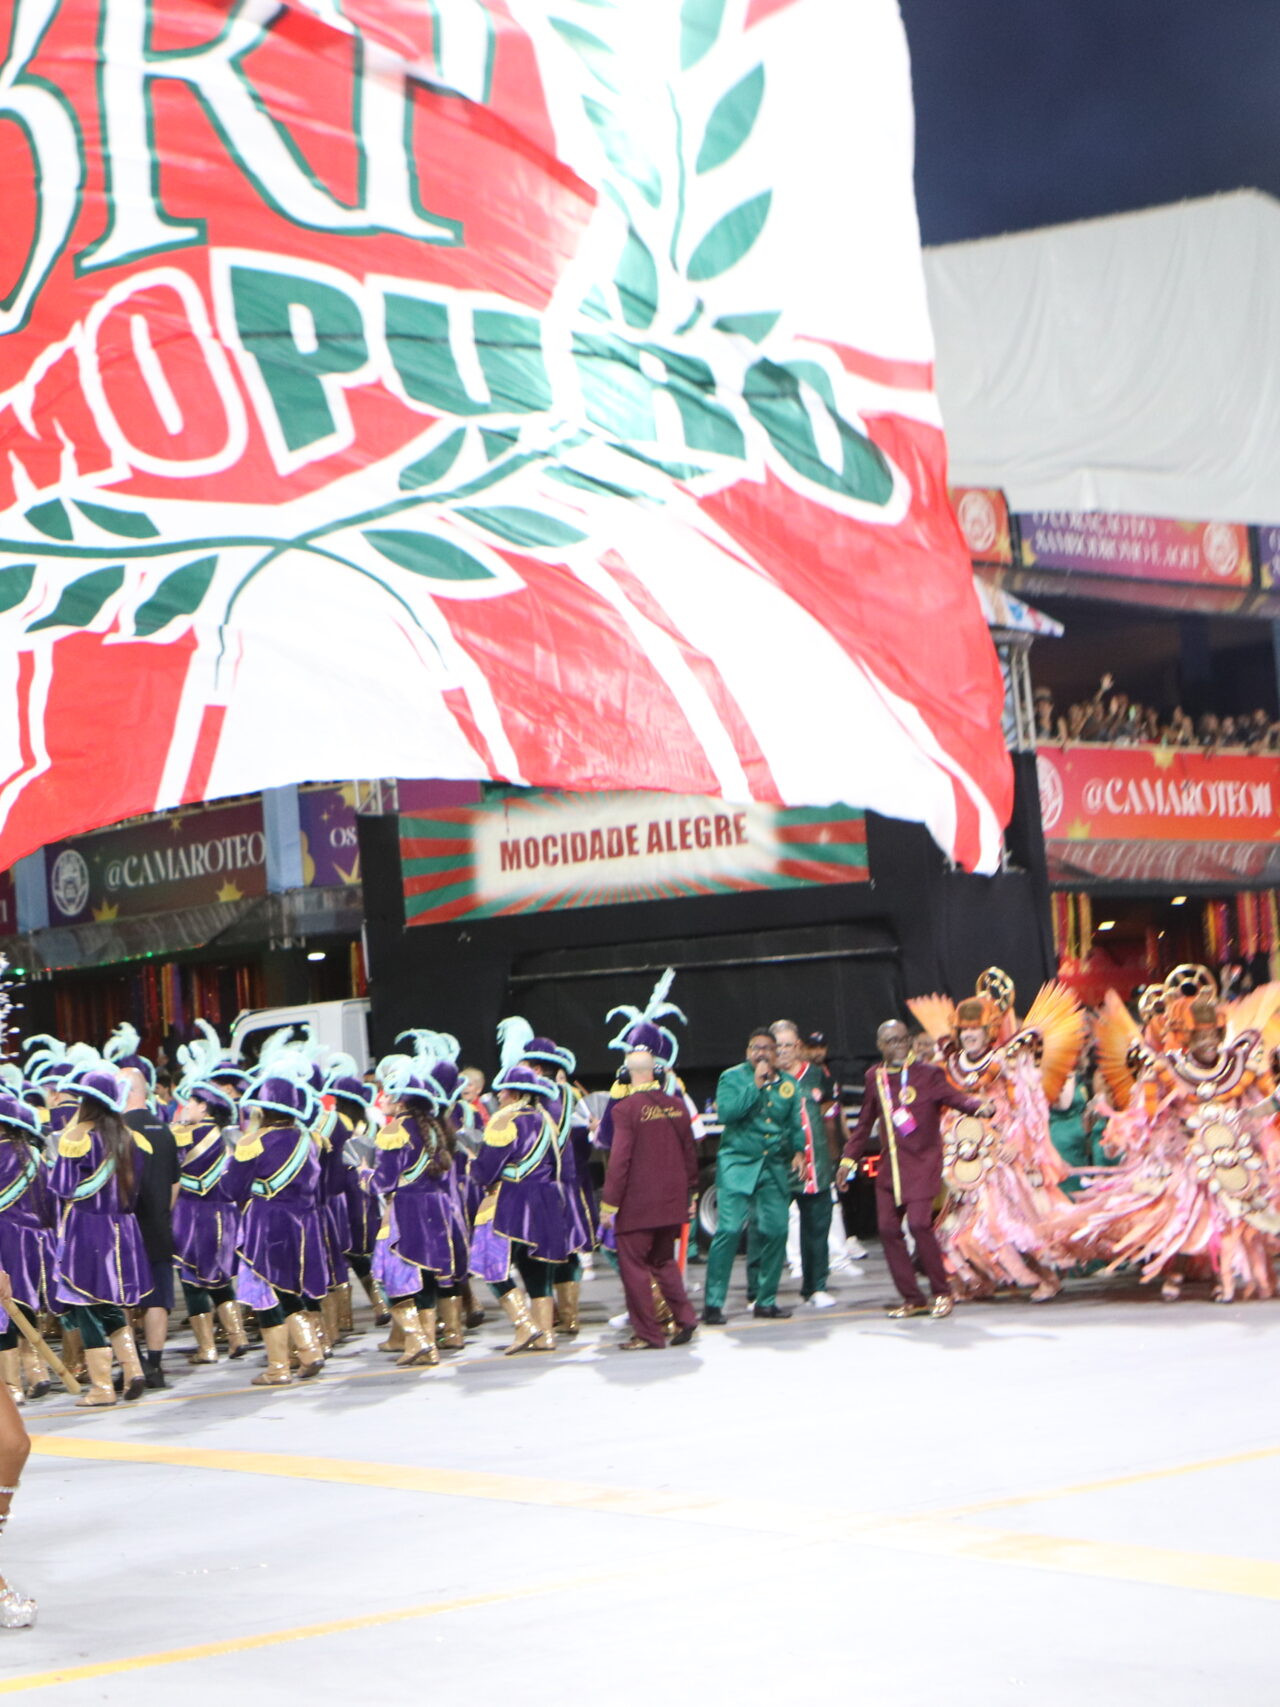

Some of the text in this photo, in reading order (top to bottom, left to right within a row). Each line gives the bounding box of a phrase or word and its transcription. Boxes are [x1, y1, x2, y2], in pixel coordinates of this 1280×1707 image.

[211, 249, 913, 525] PURO
[500, 813, 749, 872] MOCIDADE ALEGRE
